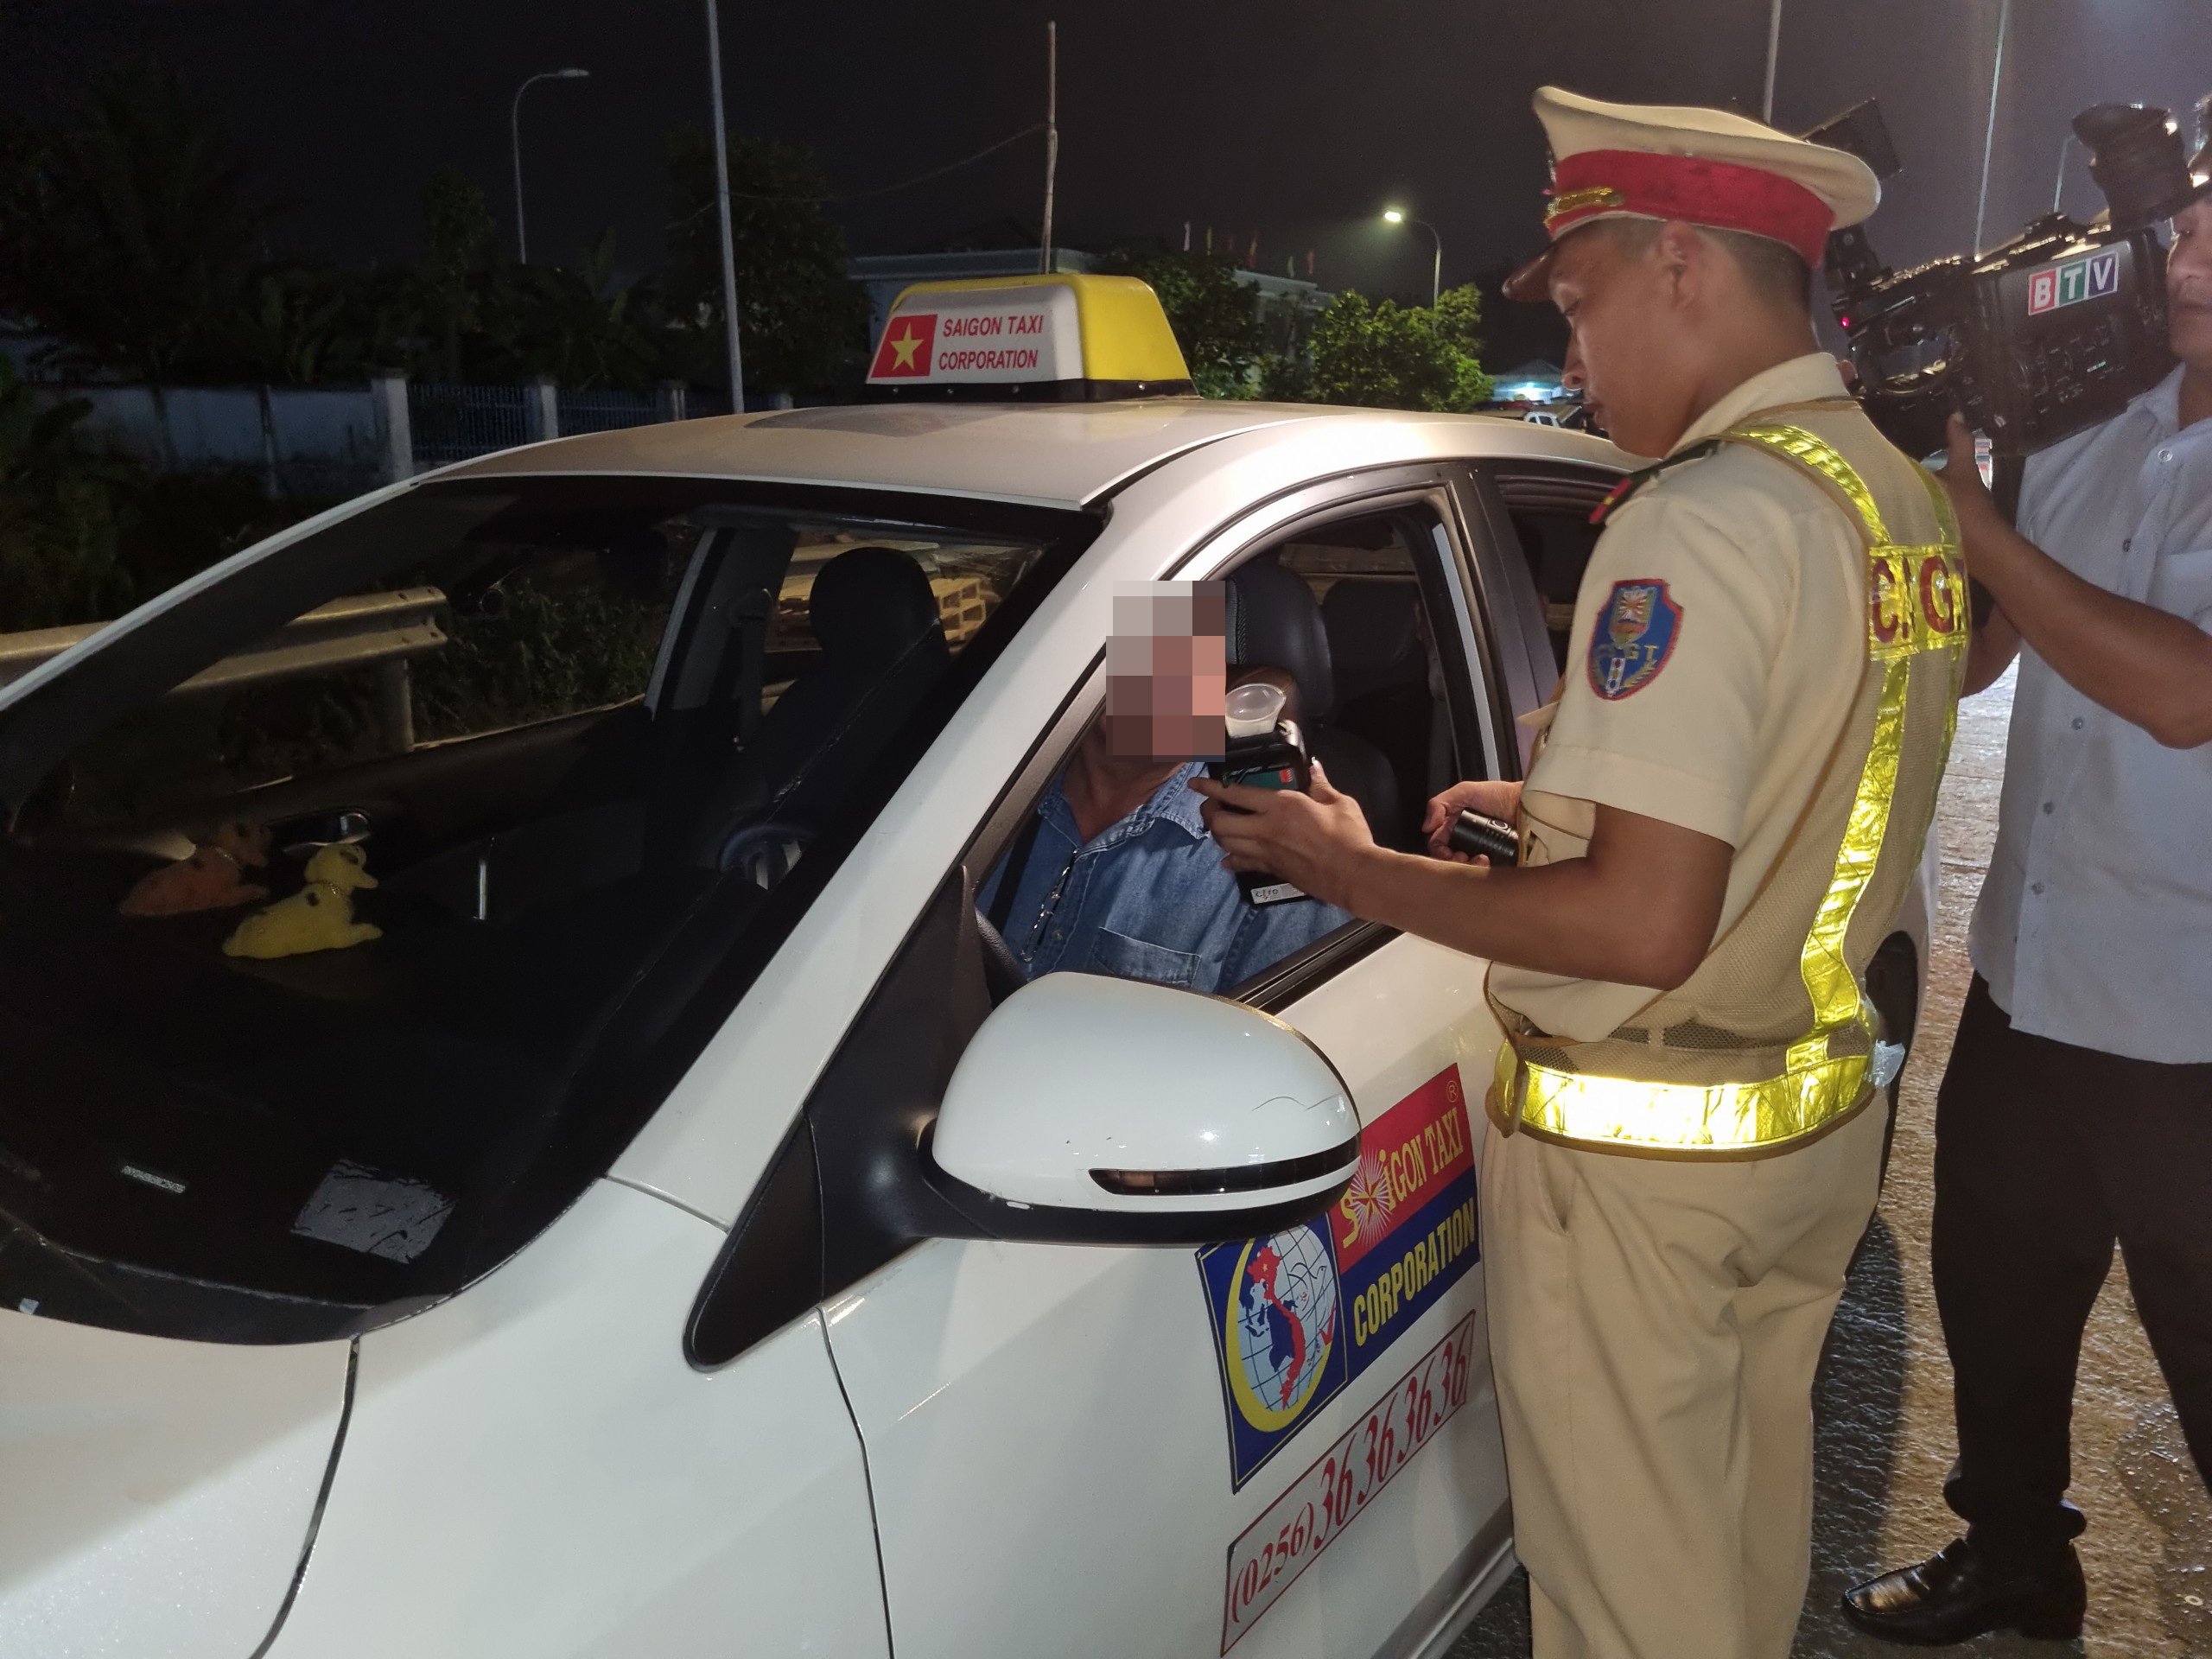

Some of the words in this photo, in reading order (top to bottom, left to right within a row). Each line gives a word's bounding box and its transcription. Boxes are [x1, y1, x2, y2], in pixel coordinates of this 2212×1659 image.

[2034, 259, 2115, 308] BTV
[943, 316, 1001, 338] SAIGON
[1007, 315, 1044, 334] TAXI
[938, 350, 1038, 371] CORPORATION
[1425, 1107, 1465, 1175] TAXI
[1354, 1198, 1476, 1347] CORPORATION
